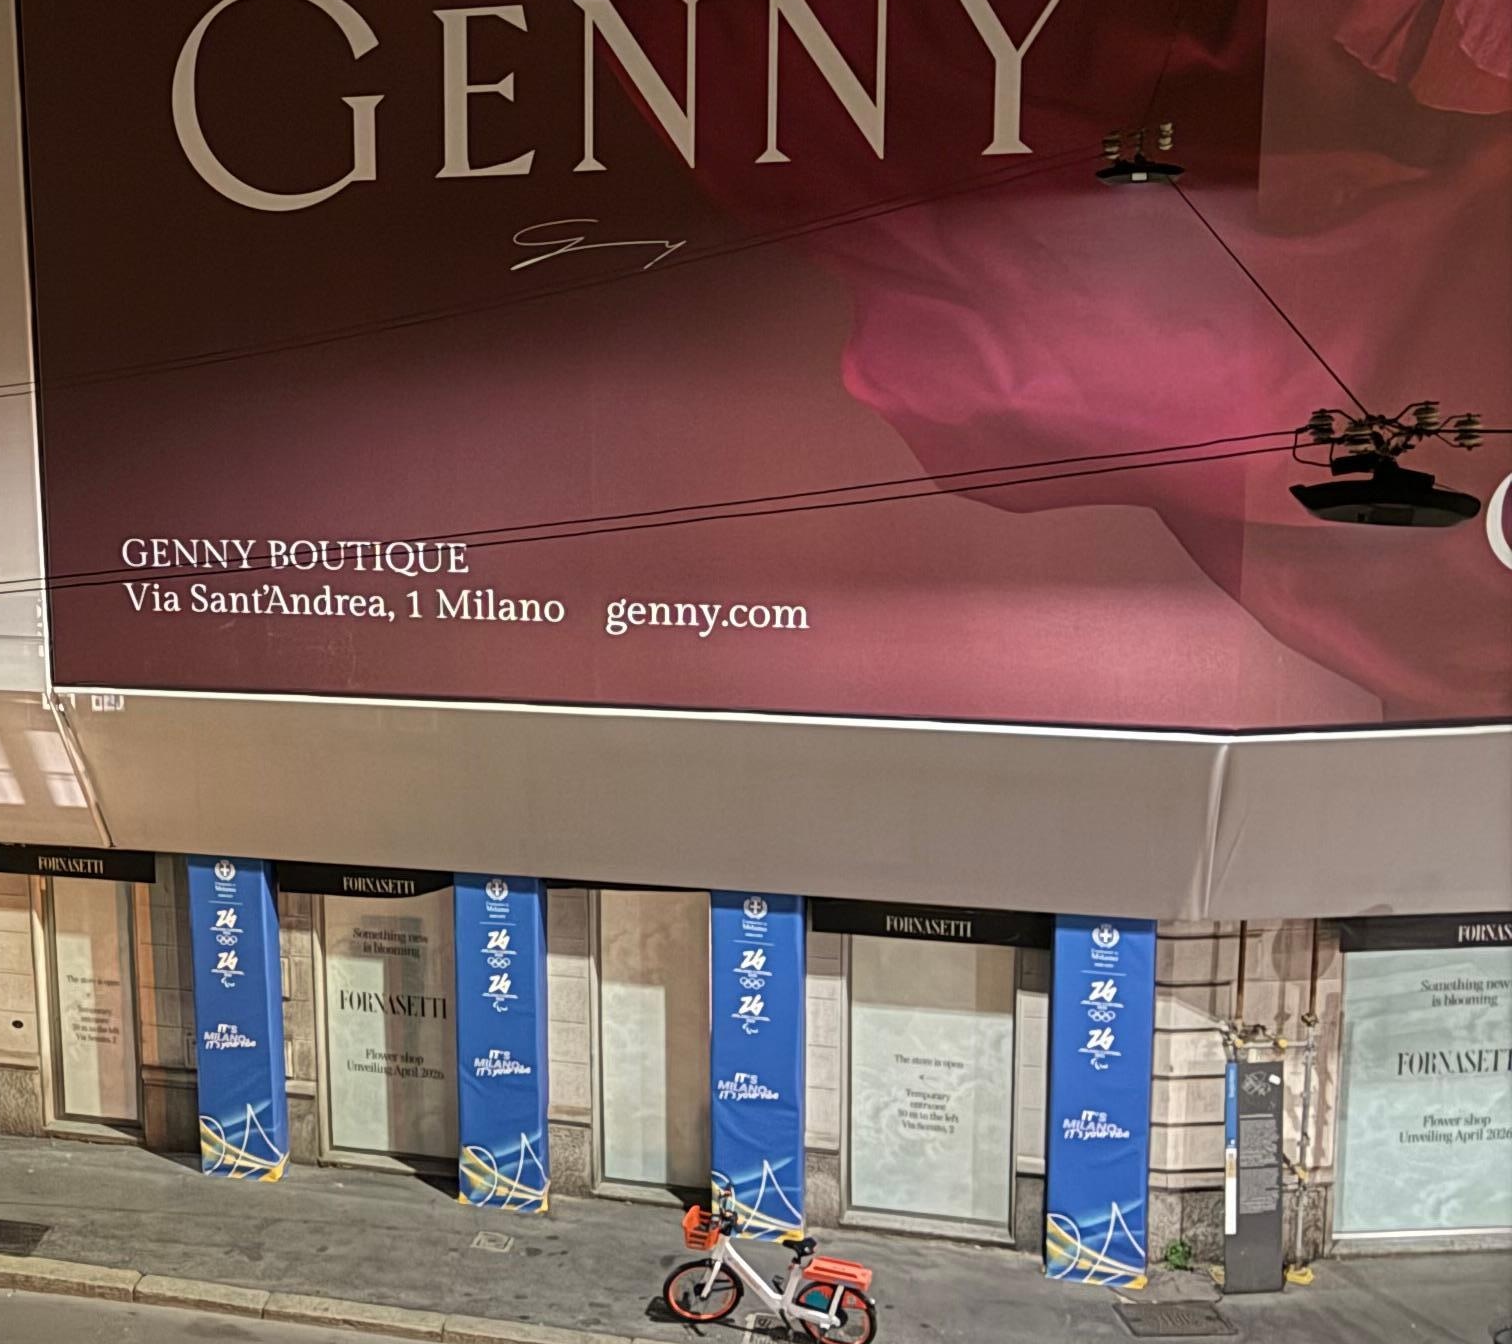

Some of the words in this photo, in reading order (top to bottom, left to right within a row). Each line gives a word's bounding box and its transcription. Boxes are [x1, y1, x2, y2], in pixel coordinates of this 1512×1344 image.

[122, 538, 257, 570] GENNY
[267, 540, 469, 577] BOUTIQUE
[123, 582, 182, 613] Via
[406, 590, 423, 618] 1
[436, 588, 566, 624] Milano
[605, 598, 811, 638] genny.com
[38, 856, 104, 874] FORNASETTI
[343, 876, 415, 895] FORNASETTI
[353, 927, 407, 944] Something
[886, 915, 973, 938] FORNASETTI
[374, 942, 420, 958] blooming
[1420, 977, 1484, 993] Something
[1486, 979, 1511, 991] new
[340, 989, 447, 1019] FORNASETTI
[1432, 994, 1441, 1007] is
[1444, 993, 1499, 1008] blooming
[366, 1048, 399, 1062] Flower
[400, 1052, 424, 1066] shop
[347, 1060, 393, 1076] Unveiling
[395, 1065, 419, 1079] April
[1423, 1114, 1461, 1128] Flower
[1463, 1113, 1492, 1127] shop
[1399, 1129, 1453, 1144] Unveiling
[1455, 1129, 1483, 1143] April
[1486, 1127, 1512, 1140] 2026
